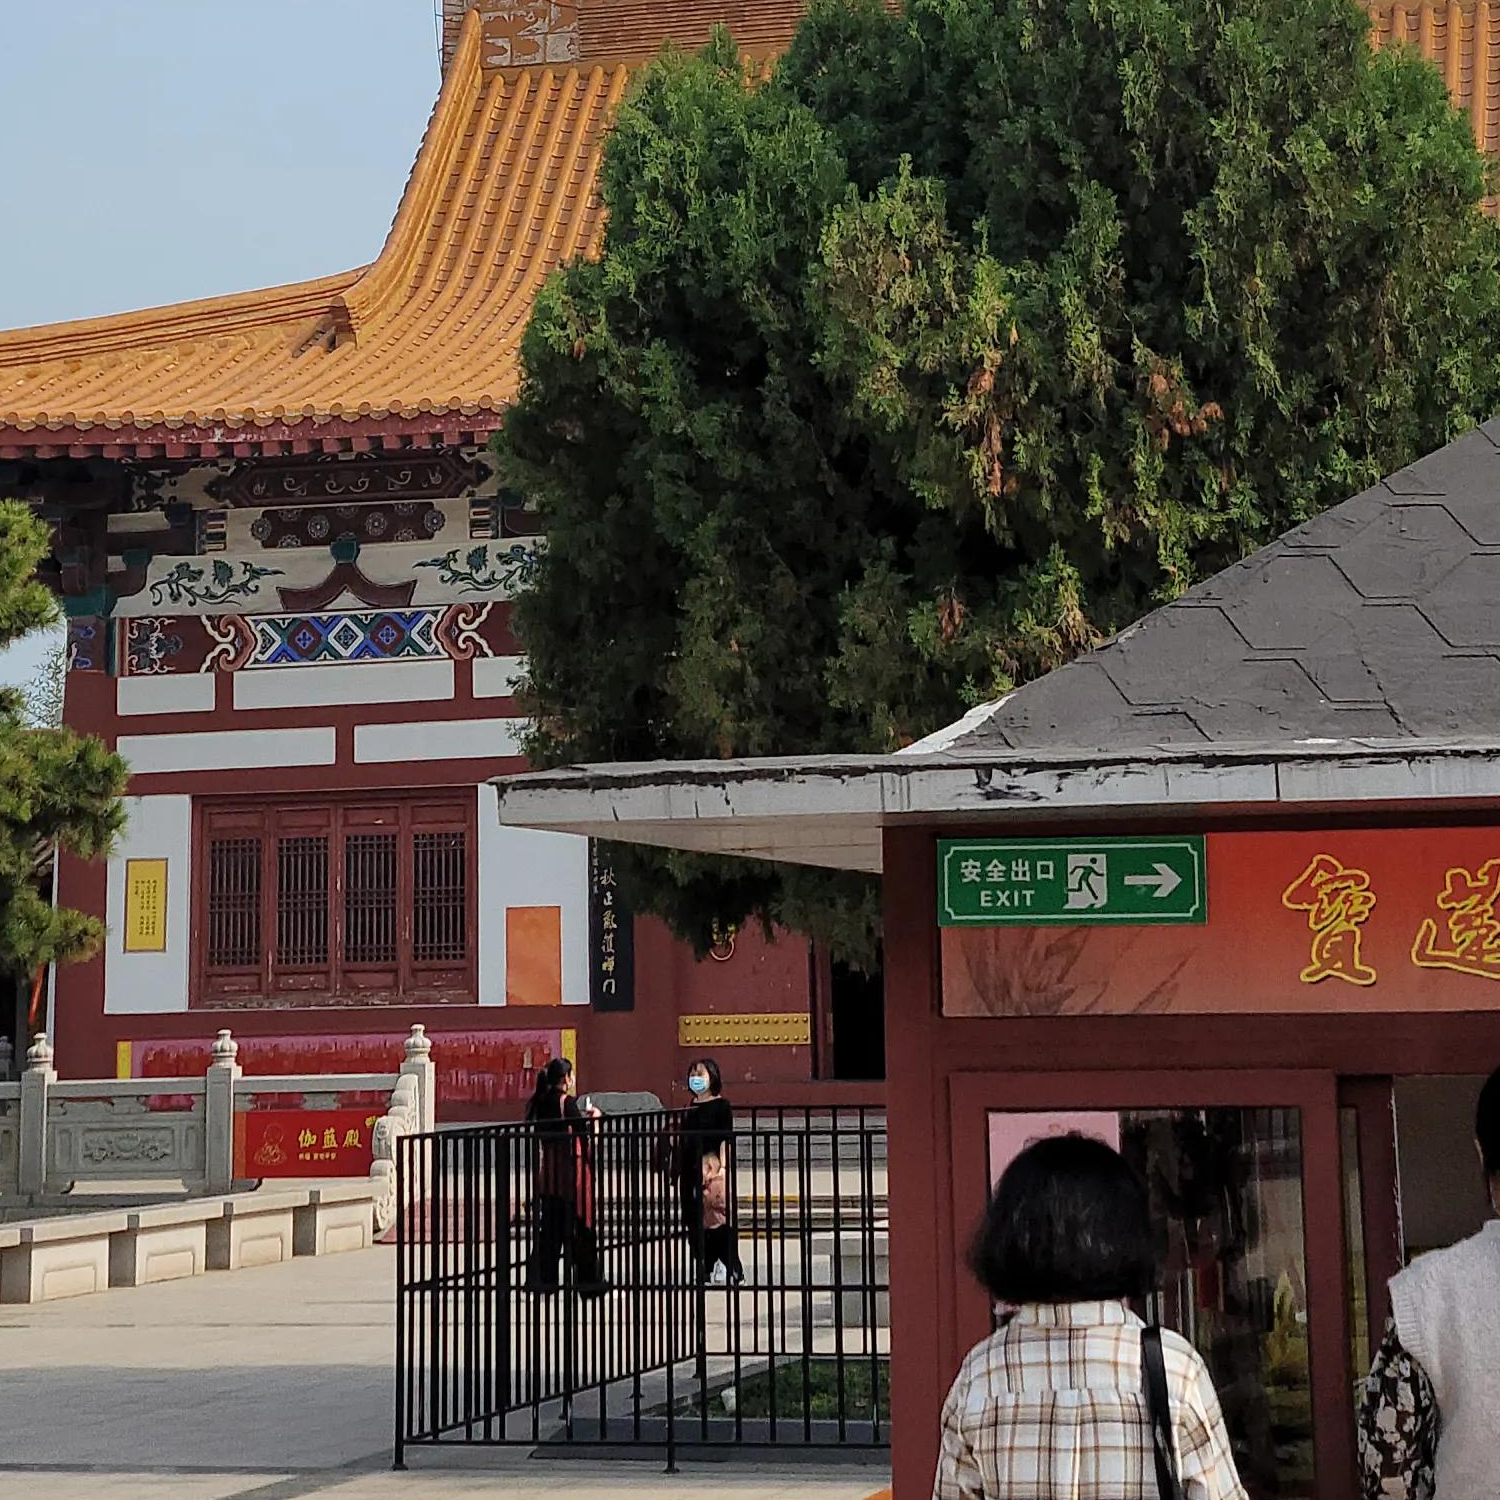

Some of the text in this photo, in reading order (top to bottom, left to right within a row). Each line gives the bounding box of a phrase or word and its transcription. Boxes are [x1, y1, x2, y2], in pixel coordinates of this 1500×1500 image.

[960, 858, 1054, 882] 安全出口
[980, 889, 1035, 907] EXIT
